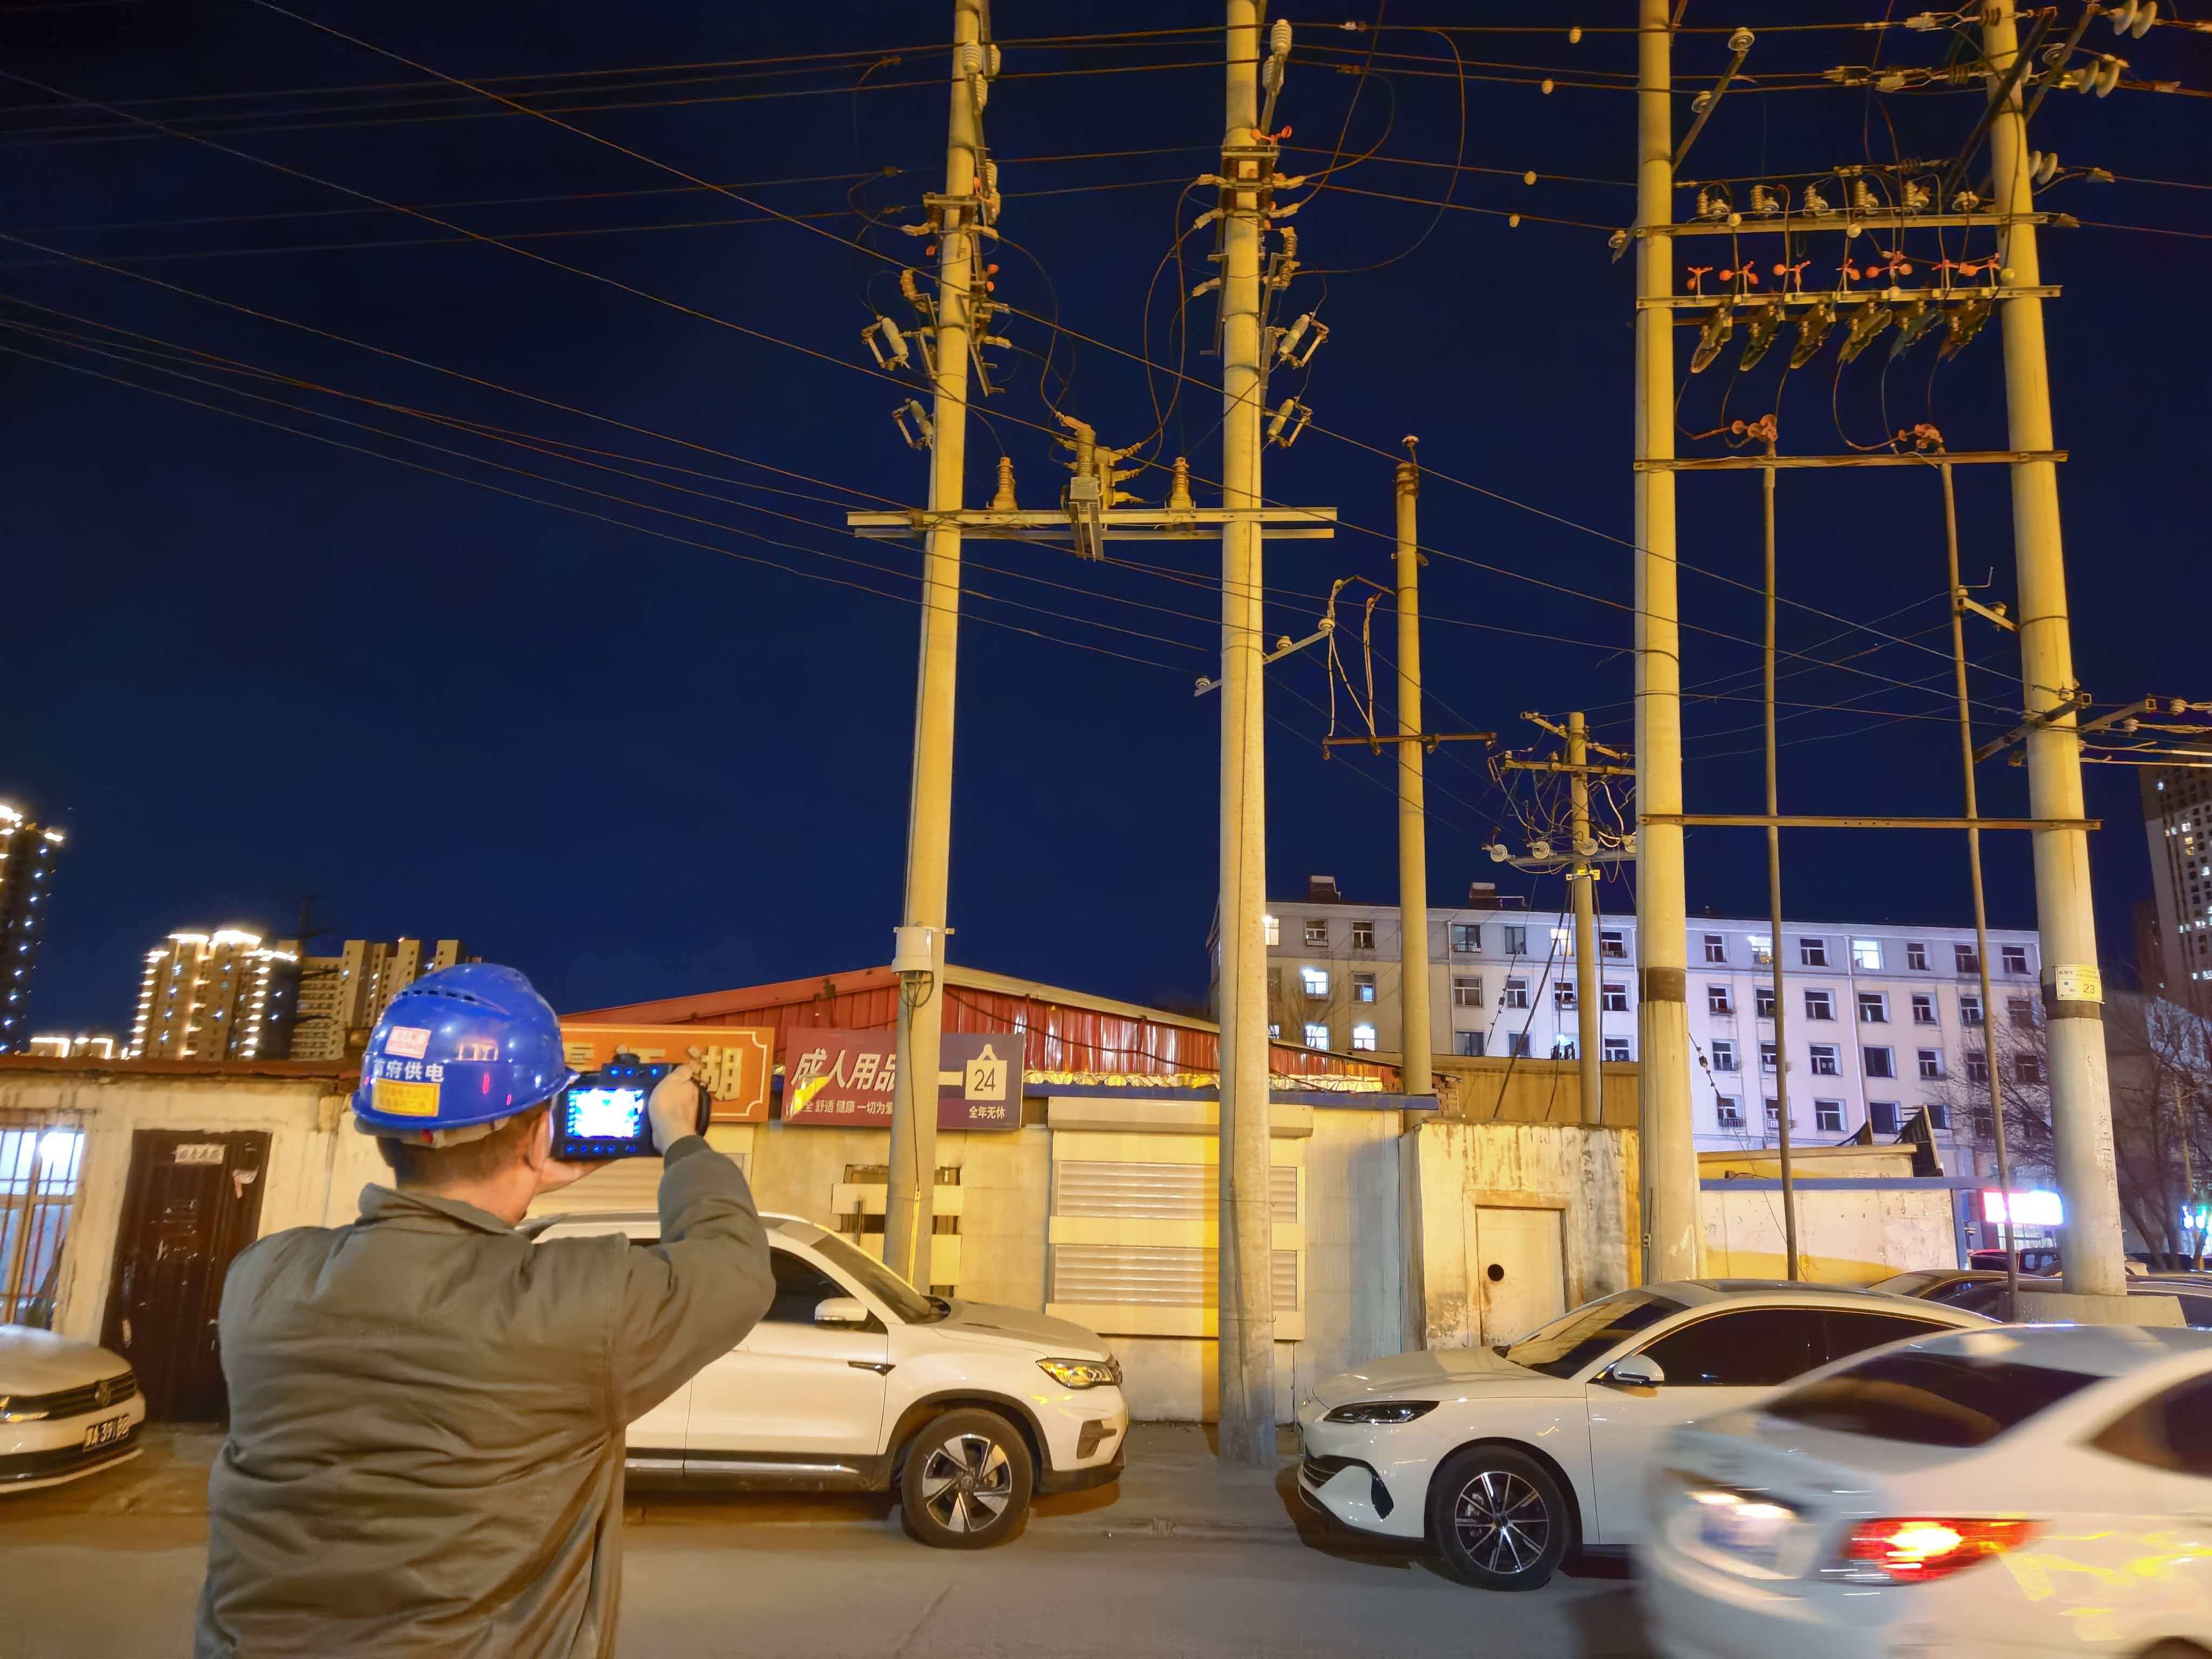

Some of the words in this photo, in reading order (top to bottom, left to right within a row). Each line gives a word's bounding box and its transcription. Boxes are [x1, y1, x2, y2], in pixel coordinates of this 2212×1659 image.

[2083, 983, 2095, 994] 23
[791, 1048, 896, 1092] 成人用品
[974, 1068, 996, 1092] 24
[837, 1100, 855, 1114] 健康
[968, 1105, 1006, 1119] 全年无休
